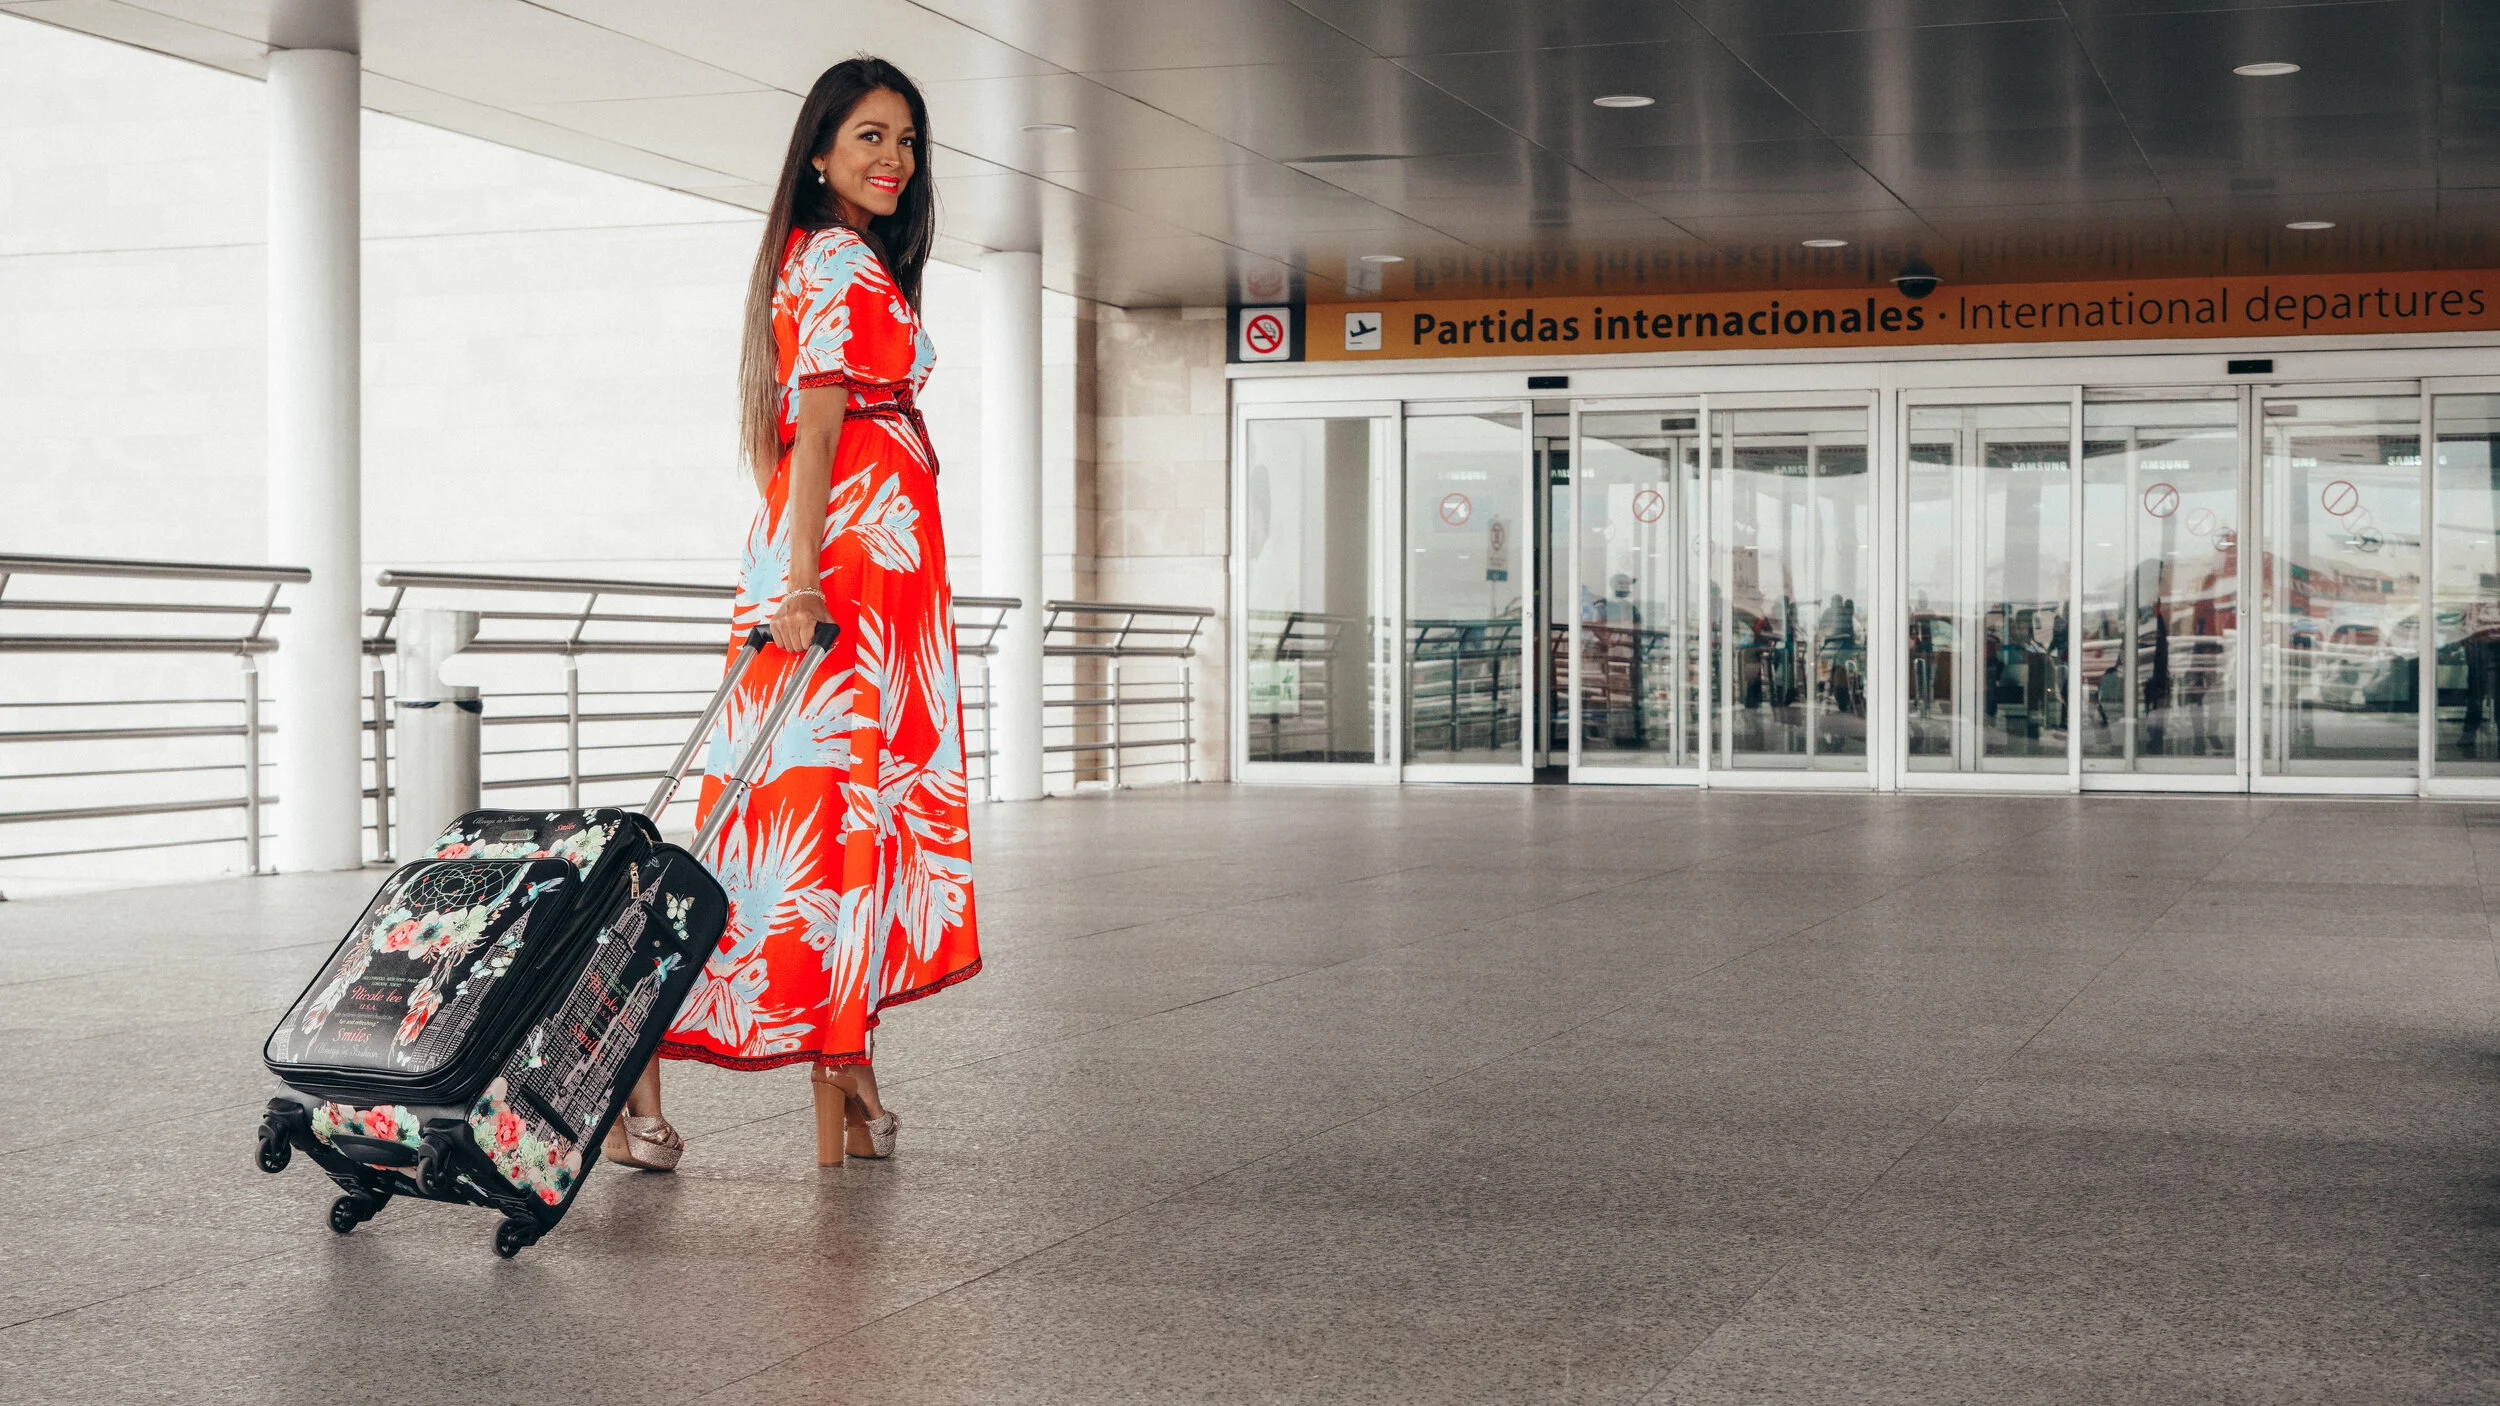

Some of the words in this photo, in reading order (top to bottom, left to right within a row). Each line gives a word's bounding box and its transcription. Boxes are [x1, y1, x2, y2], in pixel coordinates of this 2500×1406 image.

[1414, 308, 1580, 345] Partidas
[1594, 297, 1924, 341] internacionales
[1960, 287, 2227, 330] International
[2245, 286, 2485, 329] departures
[2011, 461, 2068, 472] SAMSUNG
[351, 985, 385, 1002] Nicole
[385, 988, 403, 1003] lee
[332, 1027, 372, 1044] Smiles
